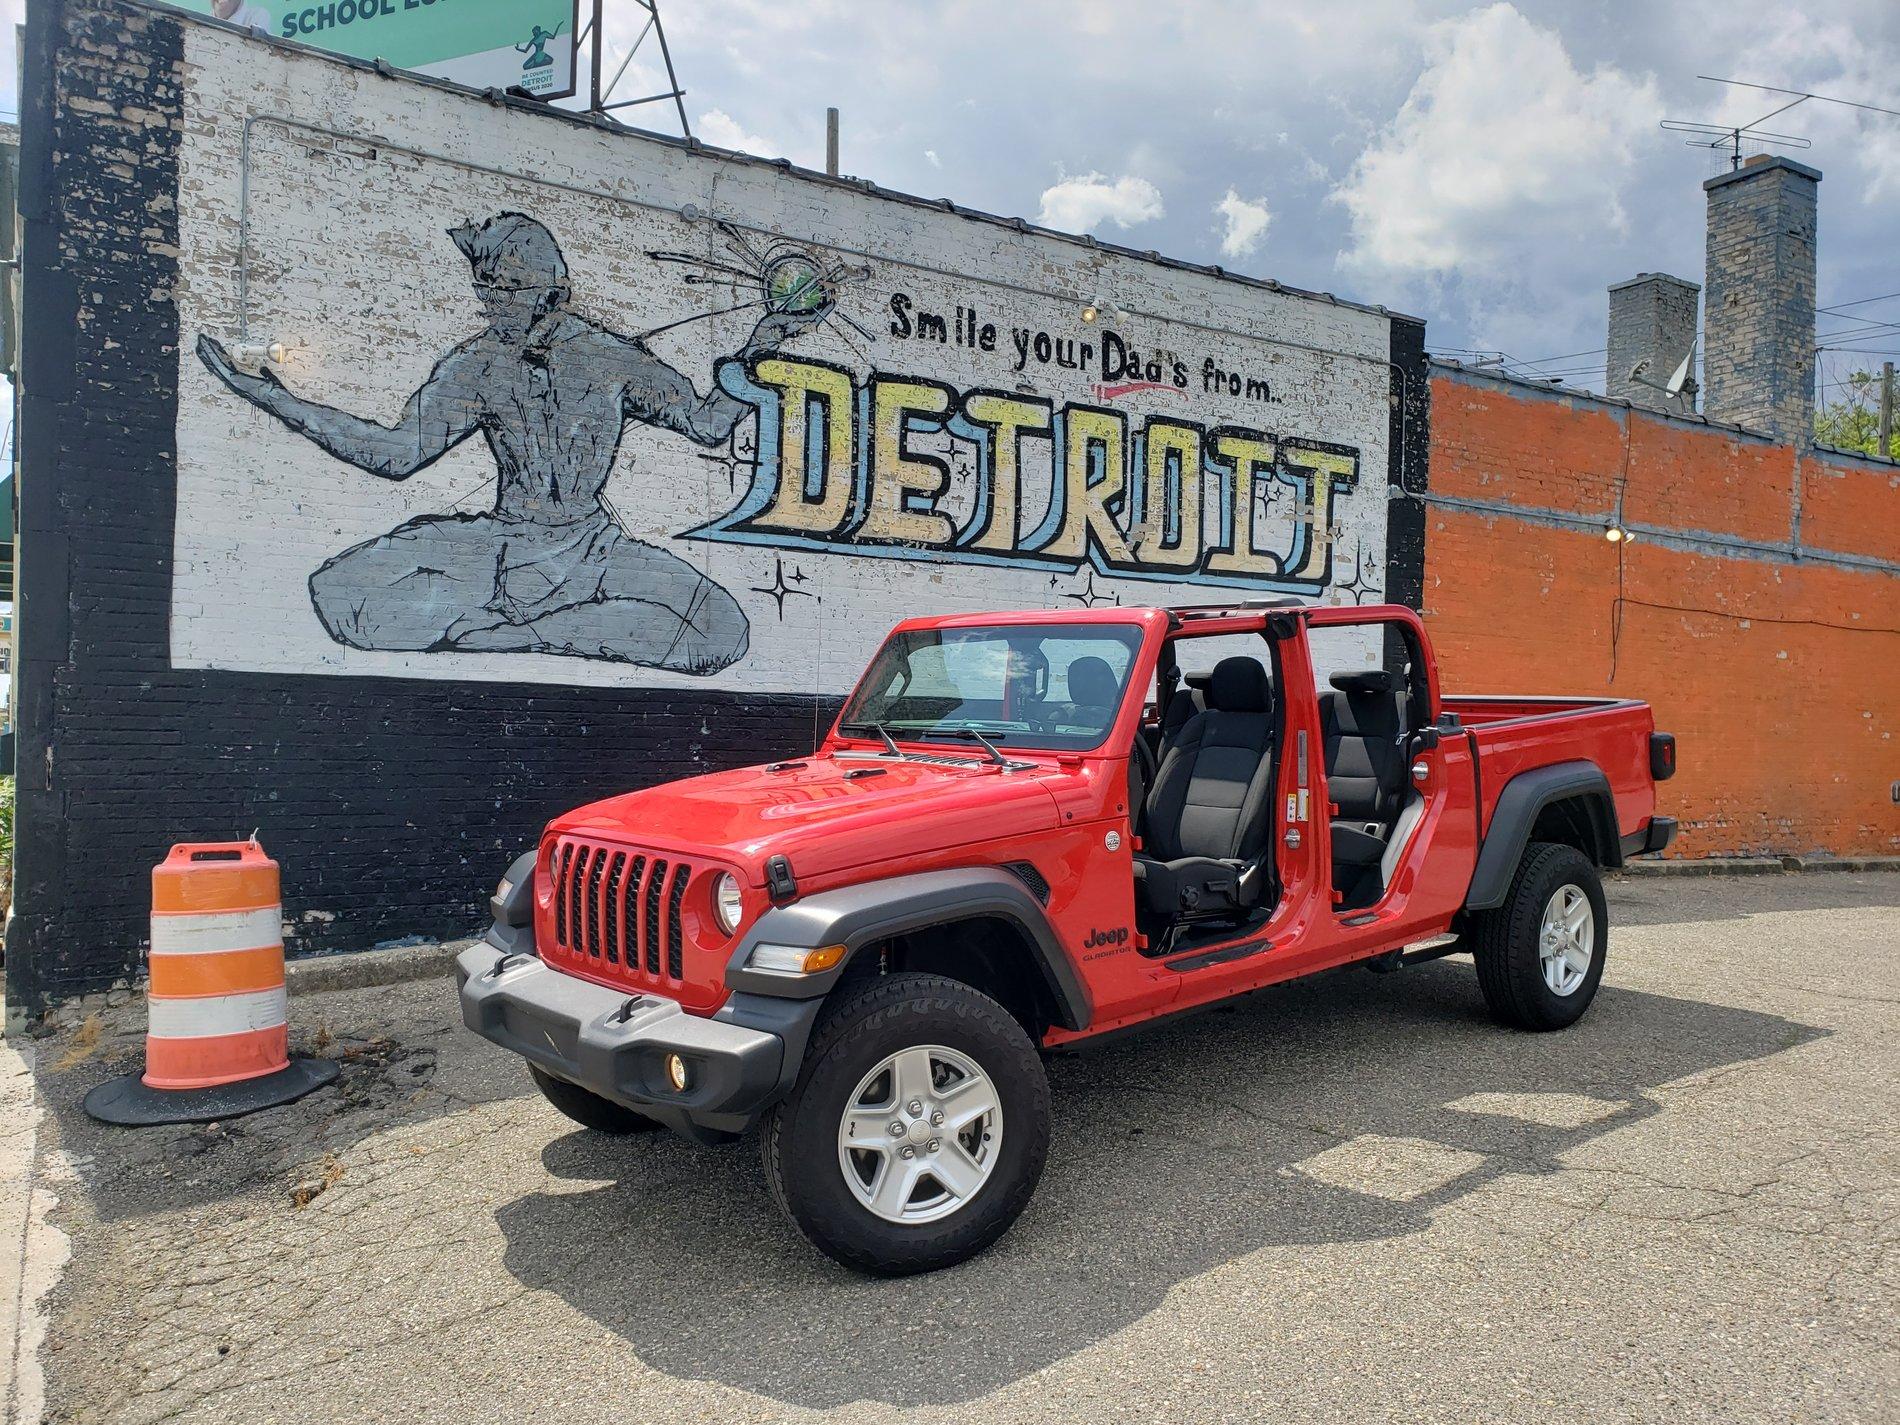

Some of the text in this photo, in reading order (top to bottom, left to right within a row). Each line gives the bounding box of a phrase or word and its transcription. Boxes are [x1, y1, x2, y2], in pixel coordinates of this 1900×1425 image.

[281, 0, 395, 38] SCHOOL
[521, 74, 554, 87] DETROIT
[890, 292, 997, 352] Smile
[1013, 328, 1093, 371] your
[1101, 330, 1189, 388] Dad's
[690, 356, 1359, 595] DETROIT
[1084, 927, 1128, 948] Jeep
[1083, 946, 1131, 961] GLADIATOR
